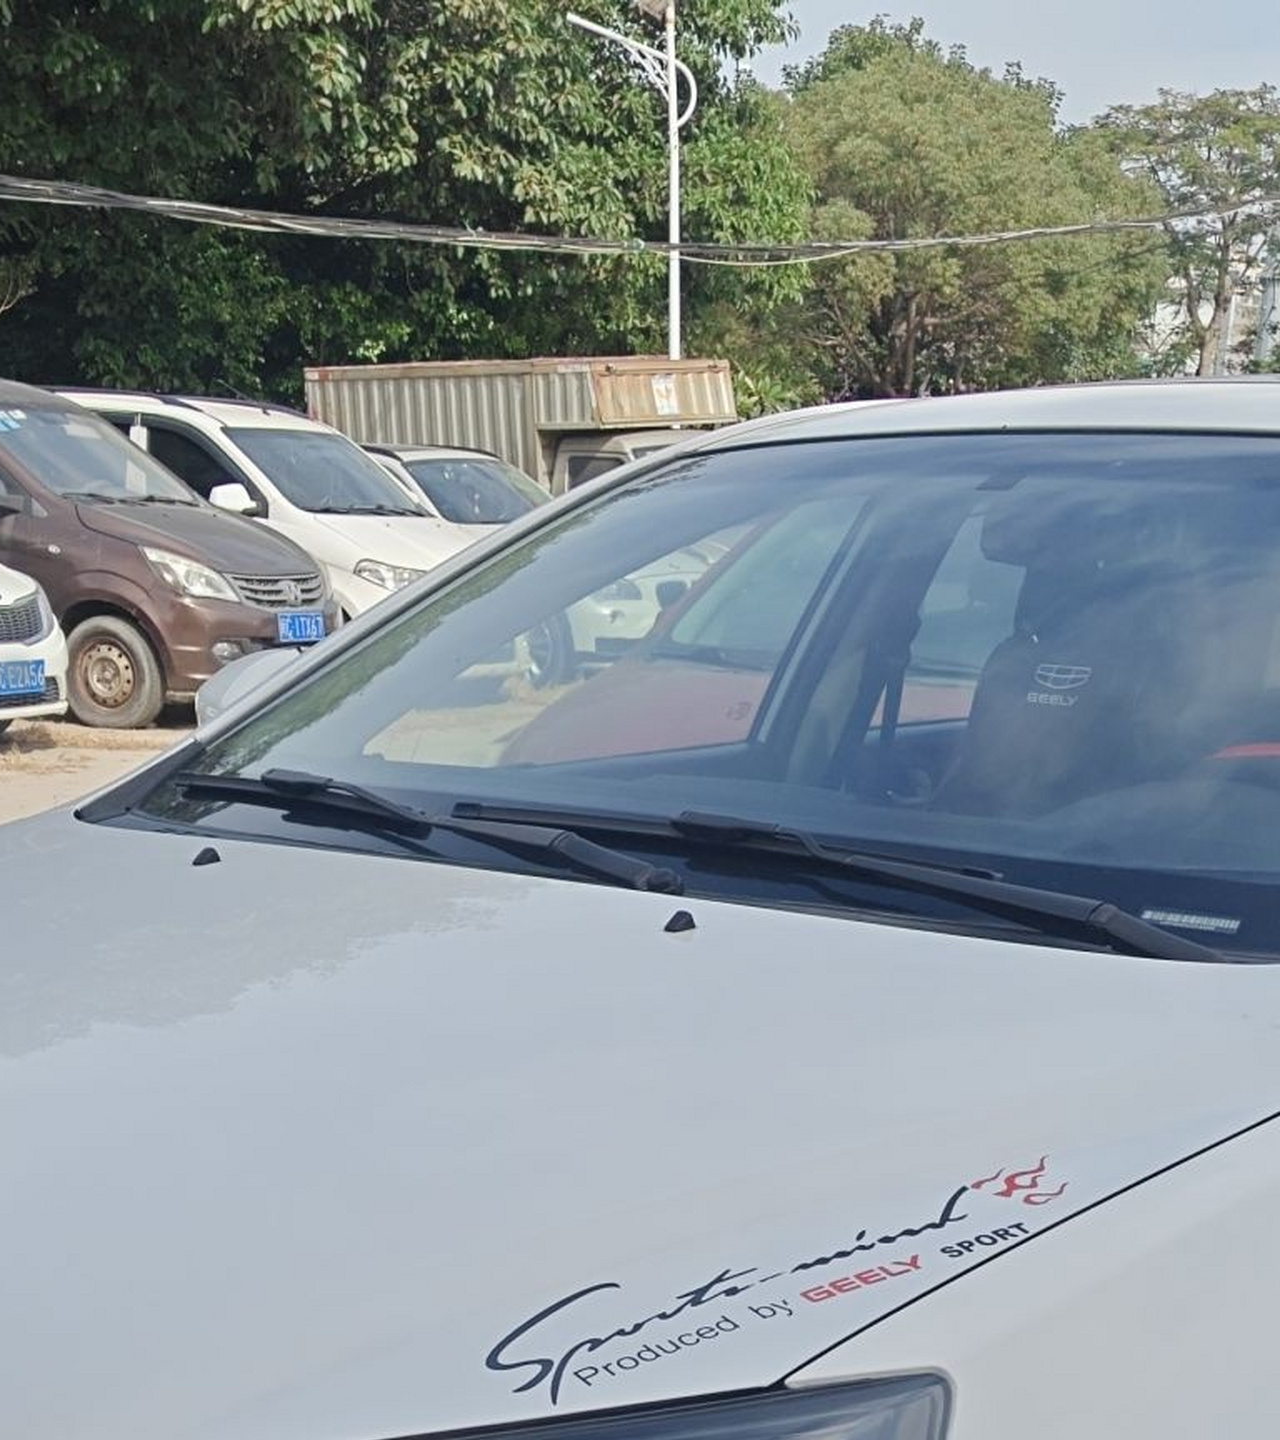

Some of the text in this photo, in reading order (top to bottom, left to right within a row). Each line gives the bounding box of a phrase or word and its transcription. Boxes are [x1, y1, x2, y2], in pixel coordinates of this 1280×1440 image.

[572, 1221, 1031, 1387] Produced by GEELY SPORT
